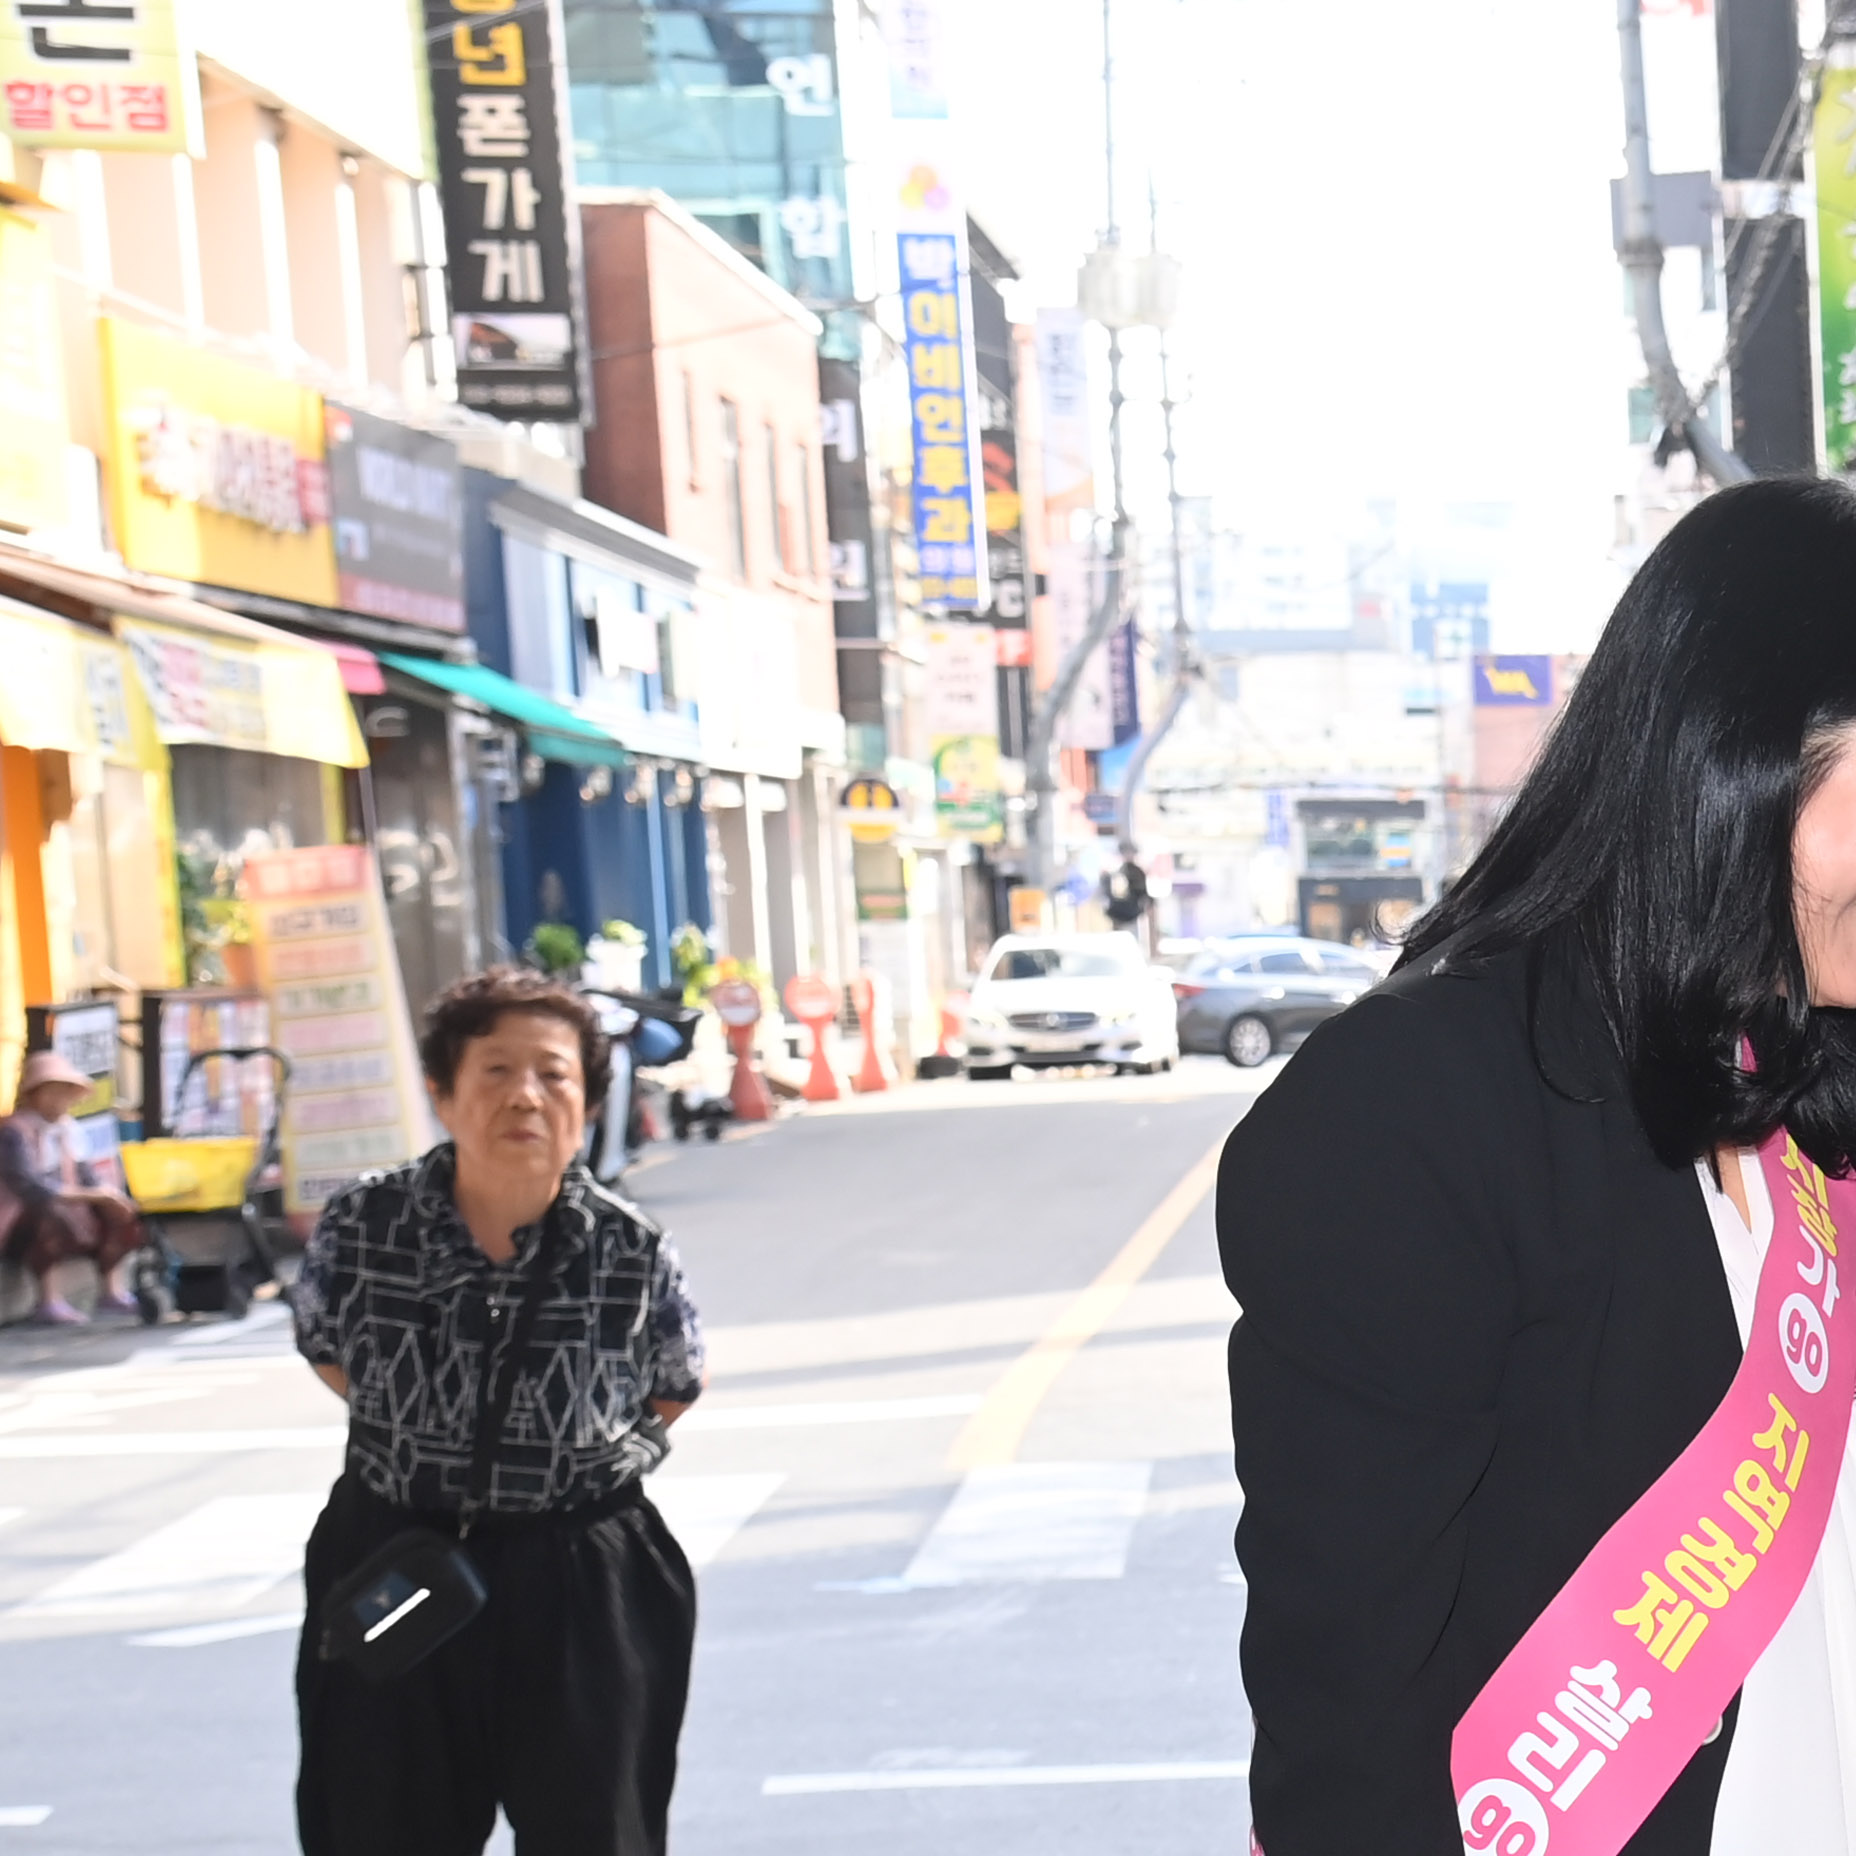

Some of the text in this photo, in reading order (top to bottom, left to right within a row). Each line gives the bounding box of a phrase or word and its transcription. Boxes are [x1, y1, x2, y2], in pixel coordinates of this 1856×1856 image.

[3, 80, 169, 133] 할인점
[452, 0, 545, 303] 년폰가게
[1614, 1392, 1812, 1674] 지역경제
